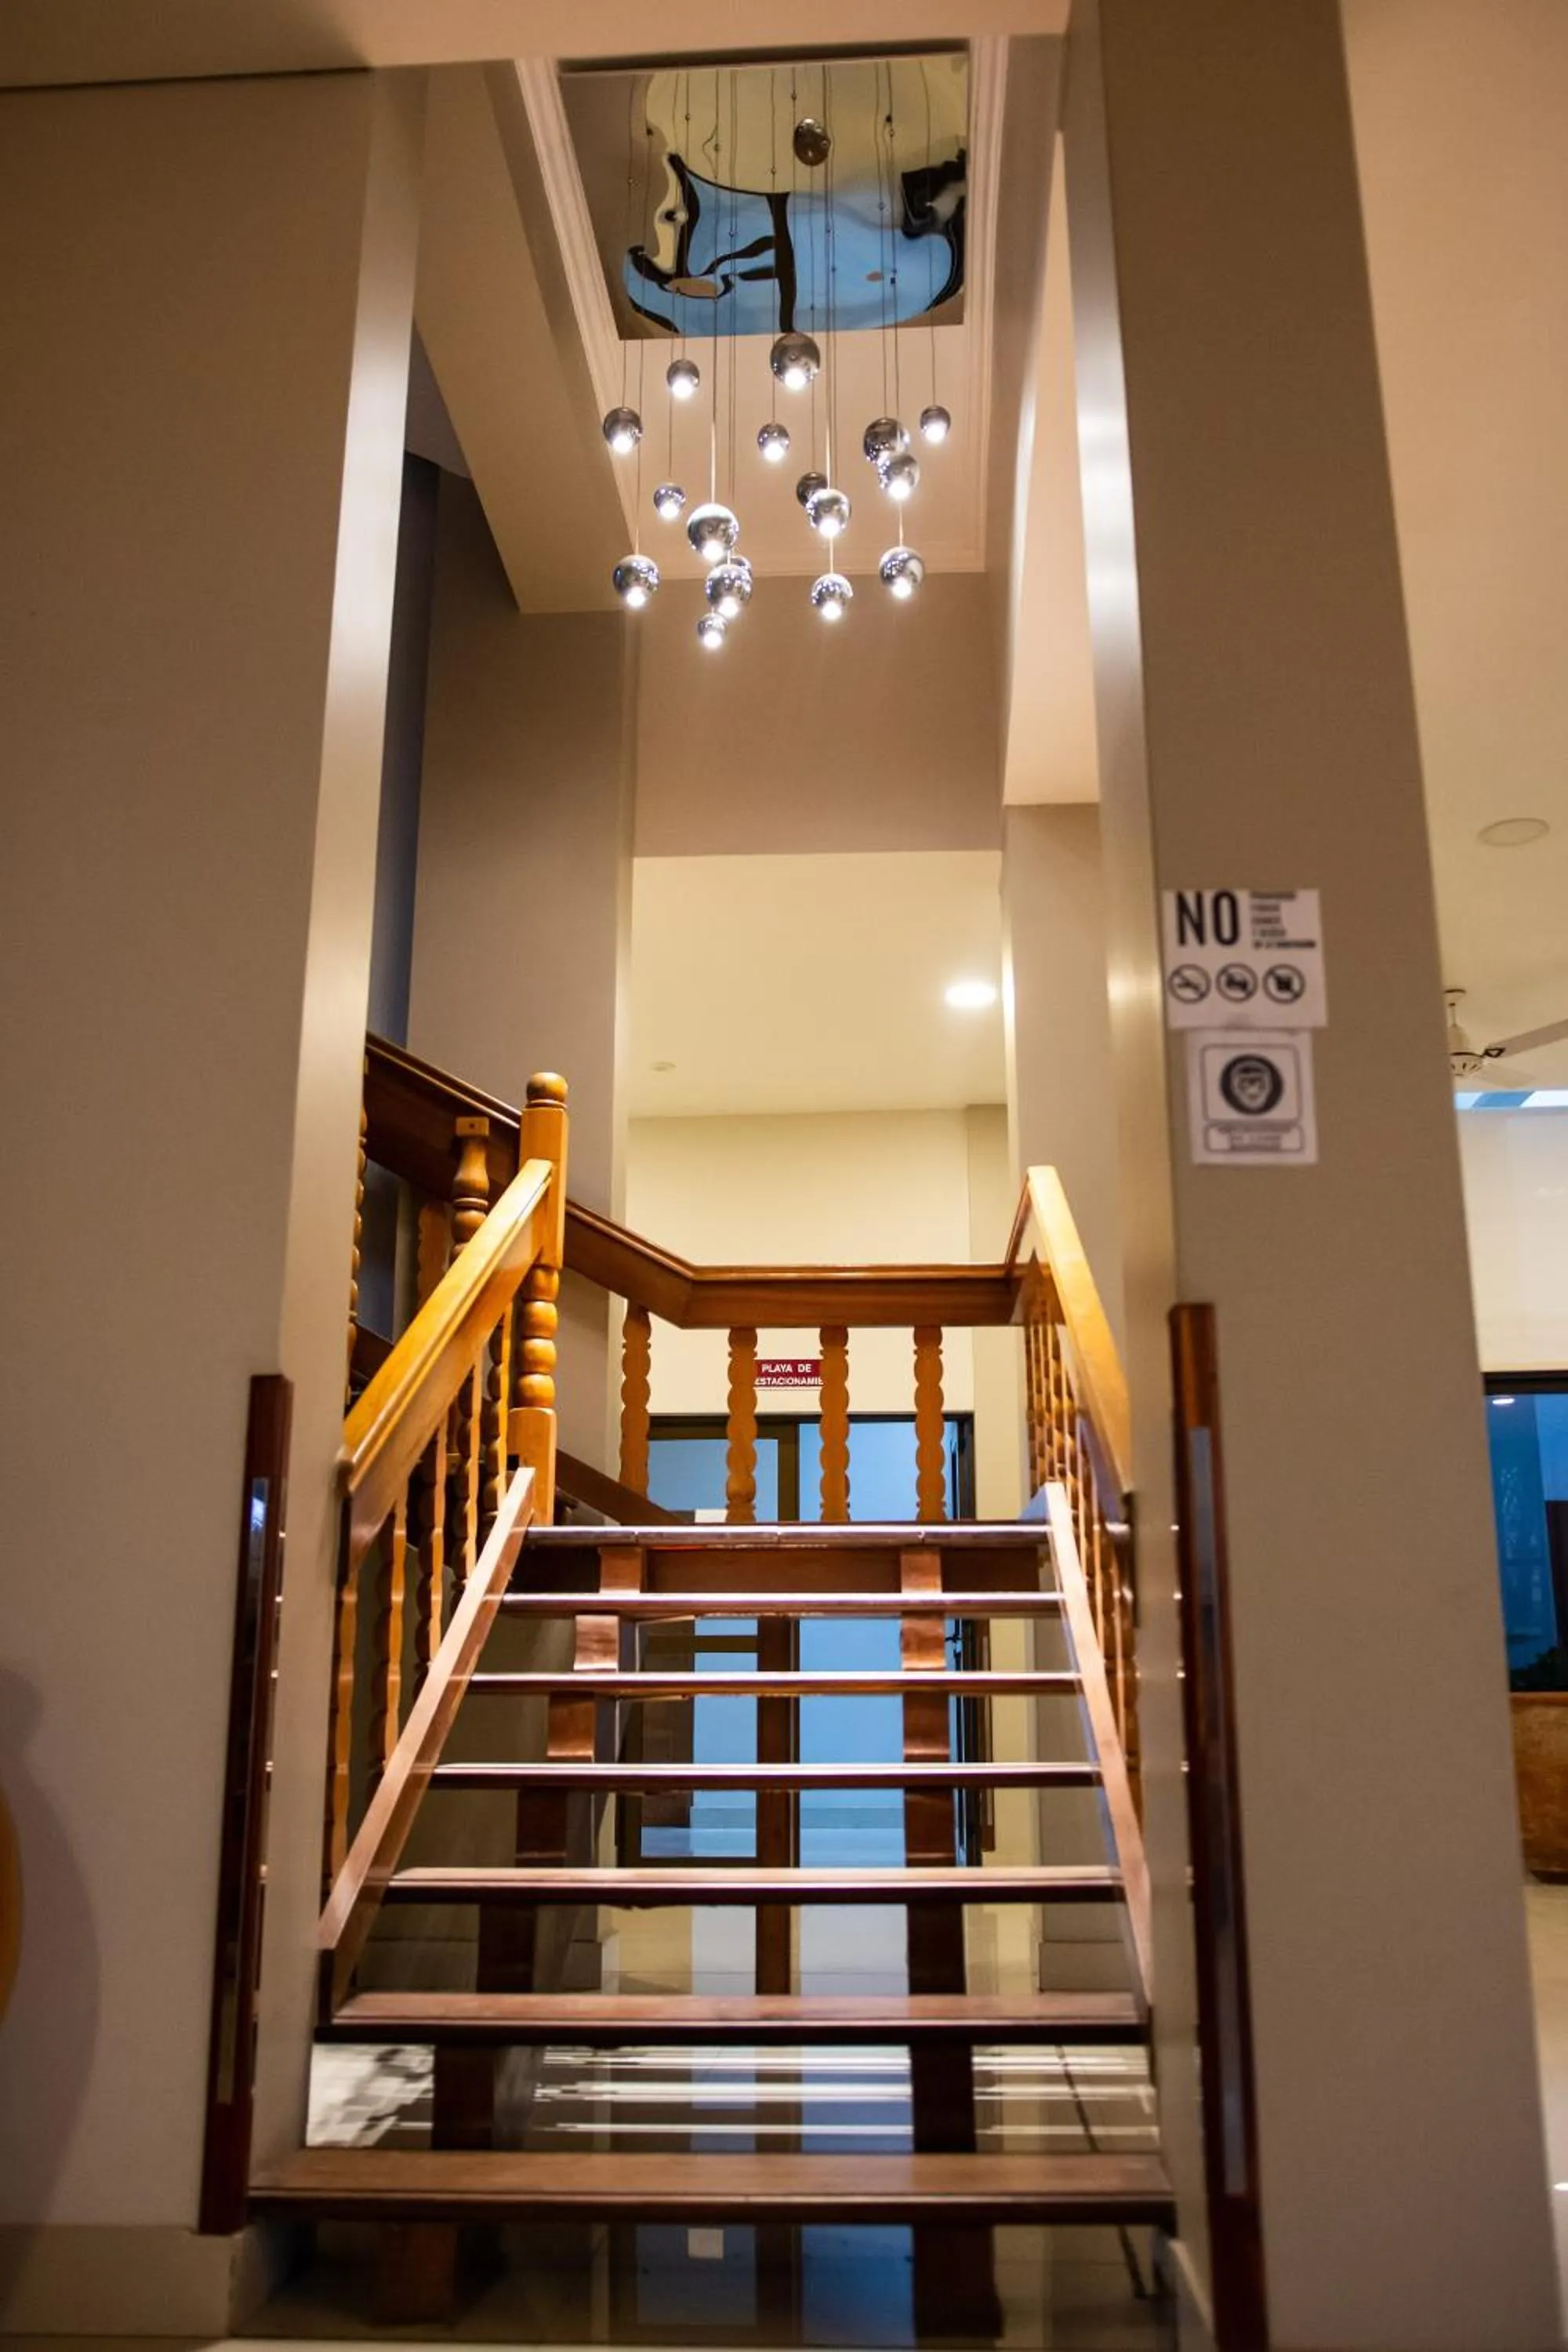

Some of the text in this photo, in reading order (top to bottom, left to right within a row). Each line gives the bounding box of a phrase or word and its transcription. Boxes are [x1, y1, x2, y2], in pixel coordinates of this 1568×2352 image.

[1177, 890, 1239, 946] NO
[761, 1364, 811, 1373] PLAYA DE
